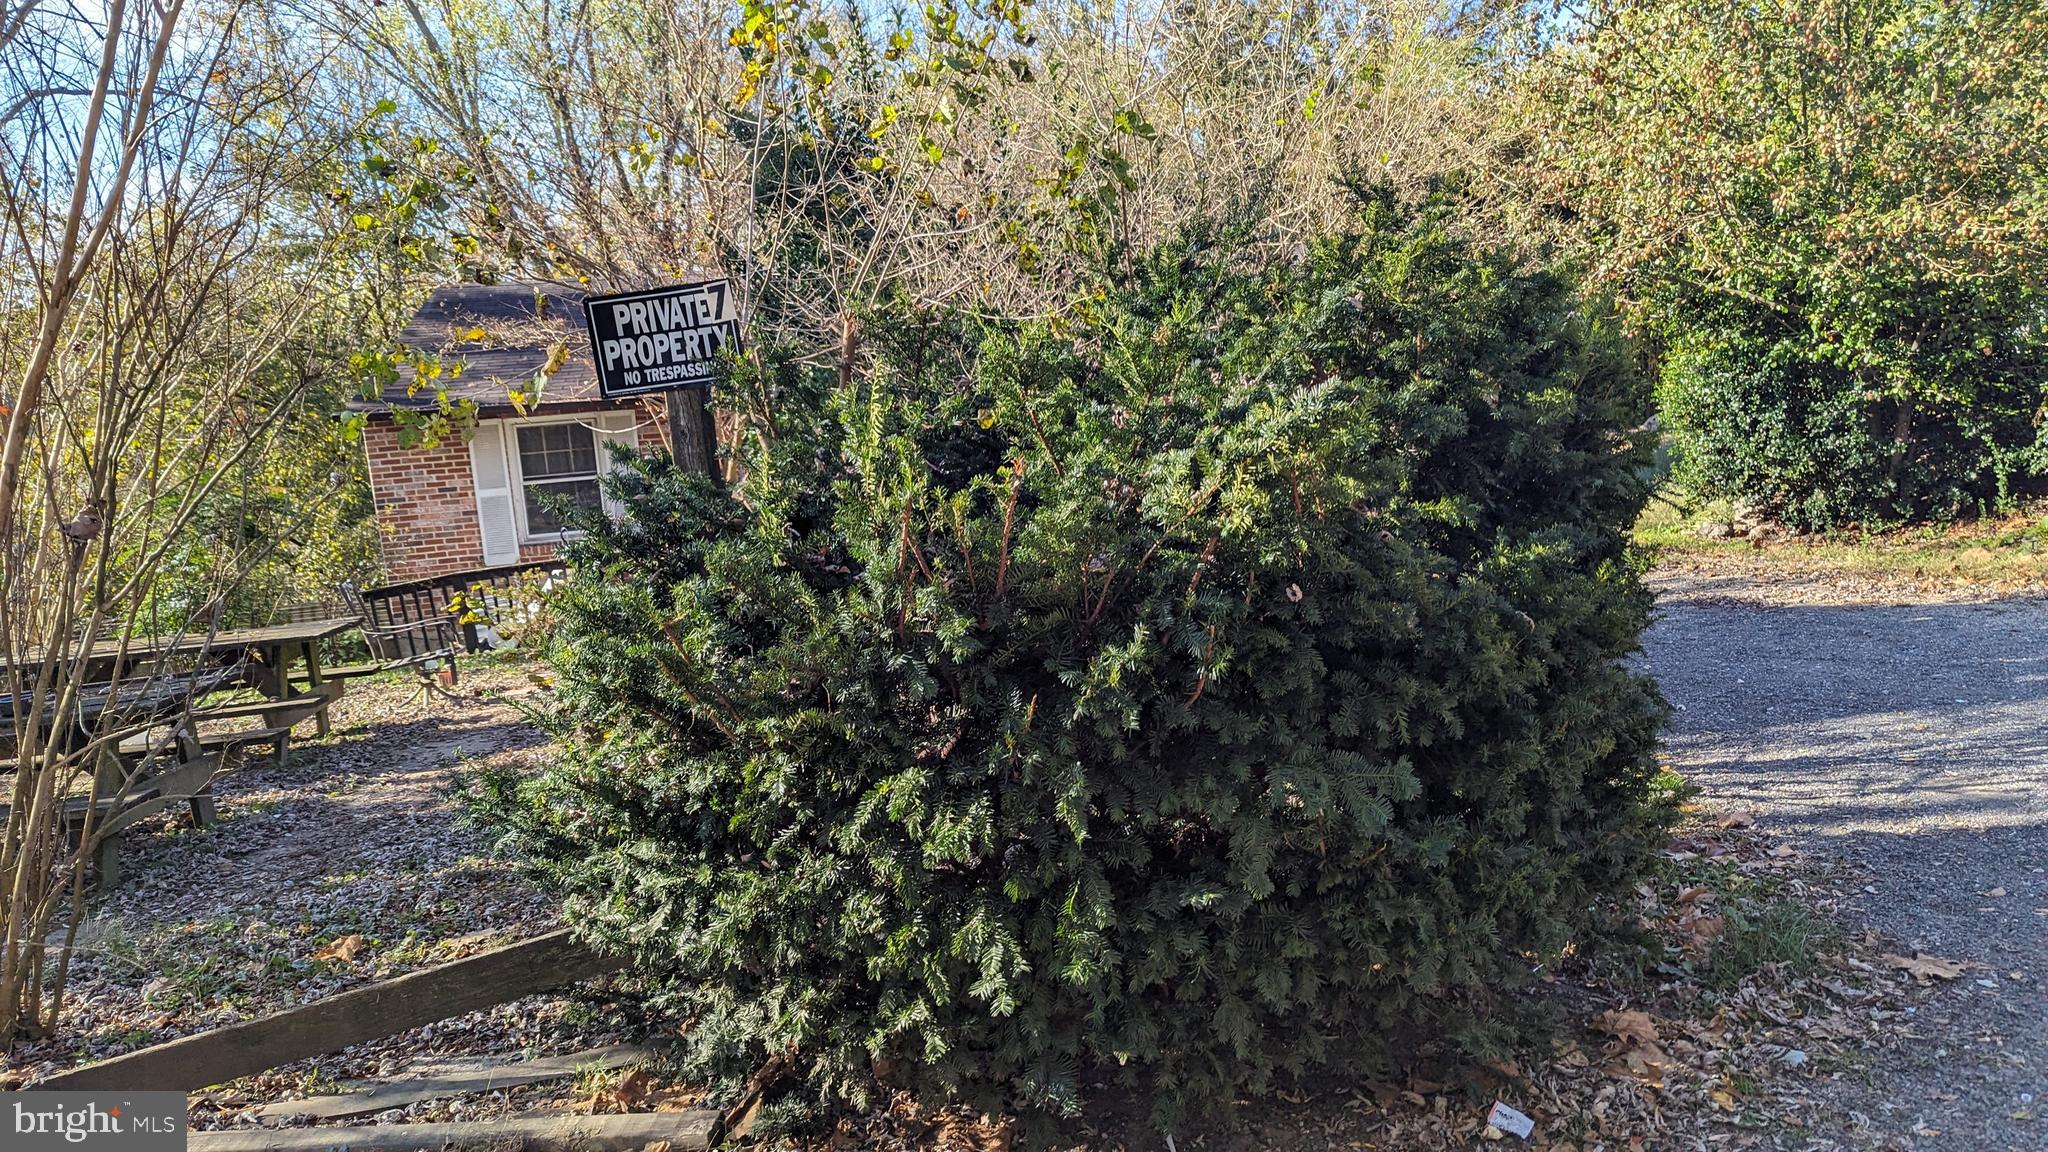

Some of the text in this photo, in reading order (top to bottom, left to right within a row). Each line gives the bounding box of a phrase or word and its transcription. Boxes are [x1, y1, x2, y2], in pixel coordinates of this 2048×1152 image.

[612, 293, 712, 337] PRIVATE
[706, 283, 726, 321] 7
[602, 323, 729, 372] PROPERTY
[623, 370, 641, 386] NO
